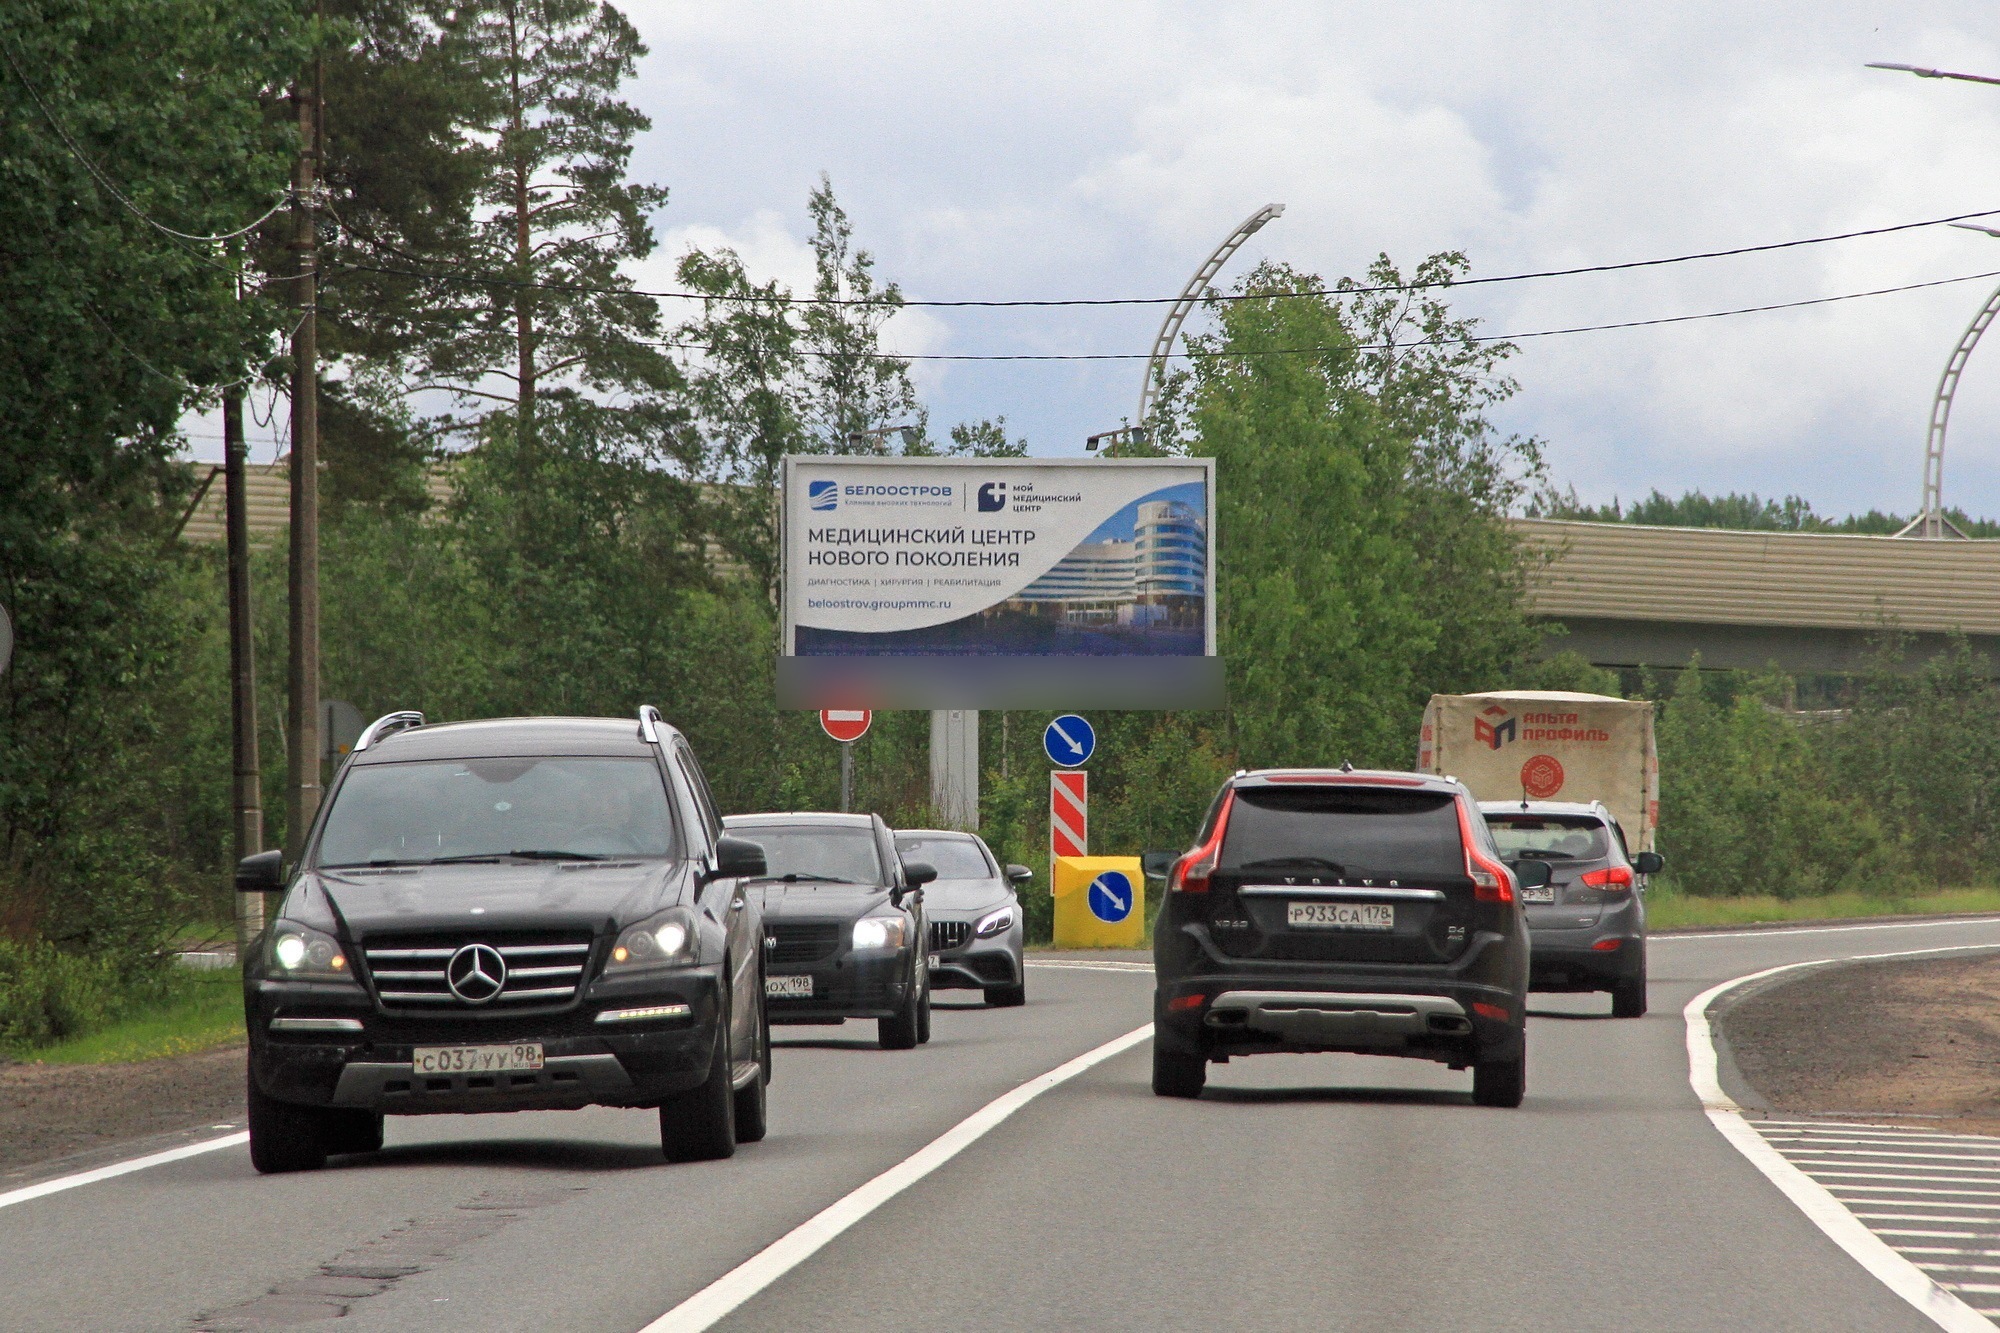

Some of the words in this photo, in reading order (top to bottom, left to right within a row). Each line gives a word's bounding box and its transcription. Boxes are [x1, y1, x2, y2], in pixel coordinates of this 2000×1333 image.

[845, 485, 952, 496] БЕЛООСТРОВ
[1013, 482, 1033, 491] МОЙ
[1013, 493, 1081, 503] МЕДИЦИНСКИЙ
[808, 527, 964, 546] МЕДИЦИНСКИЙ
[972, 530, 1036, 546] ЦЕНТР
[808, 551, 889, 565] НОВОГО
[896, 551, 1020, 567] ПОКОЛЕНИЯ
[808, 578, 870, 587] ДИАГНОСТИКА
[880, 578, 923, 586] ХИРУРГИЯ
[933, 579, 1001, 587] РЕАБИЛИТАЦИЯ
[808, 598, 951, 611] beloostrov.groupmmc.ru
[1522, 712, 1578, 725] АЛЬТА
[1521, 727, 1609, 741] ПРОФИЛЬ
[1284, 877, 1398, 887] VOLVO
